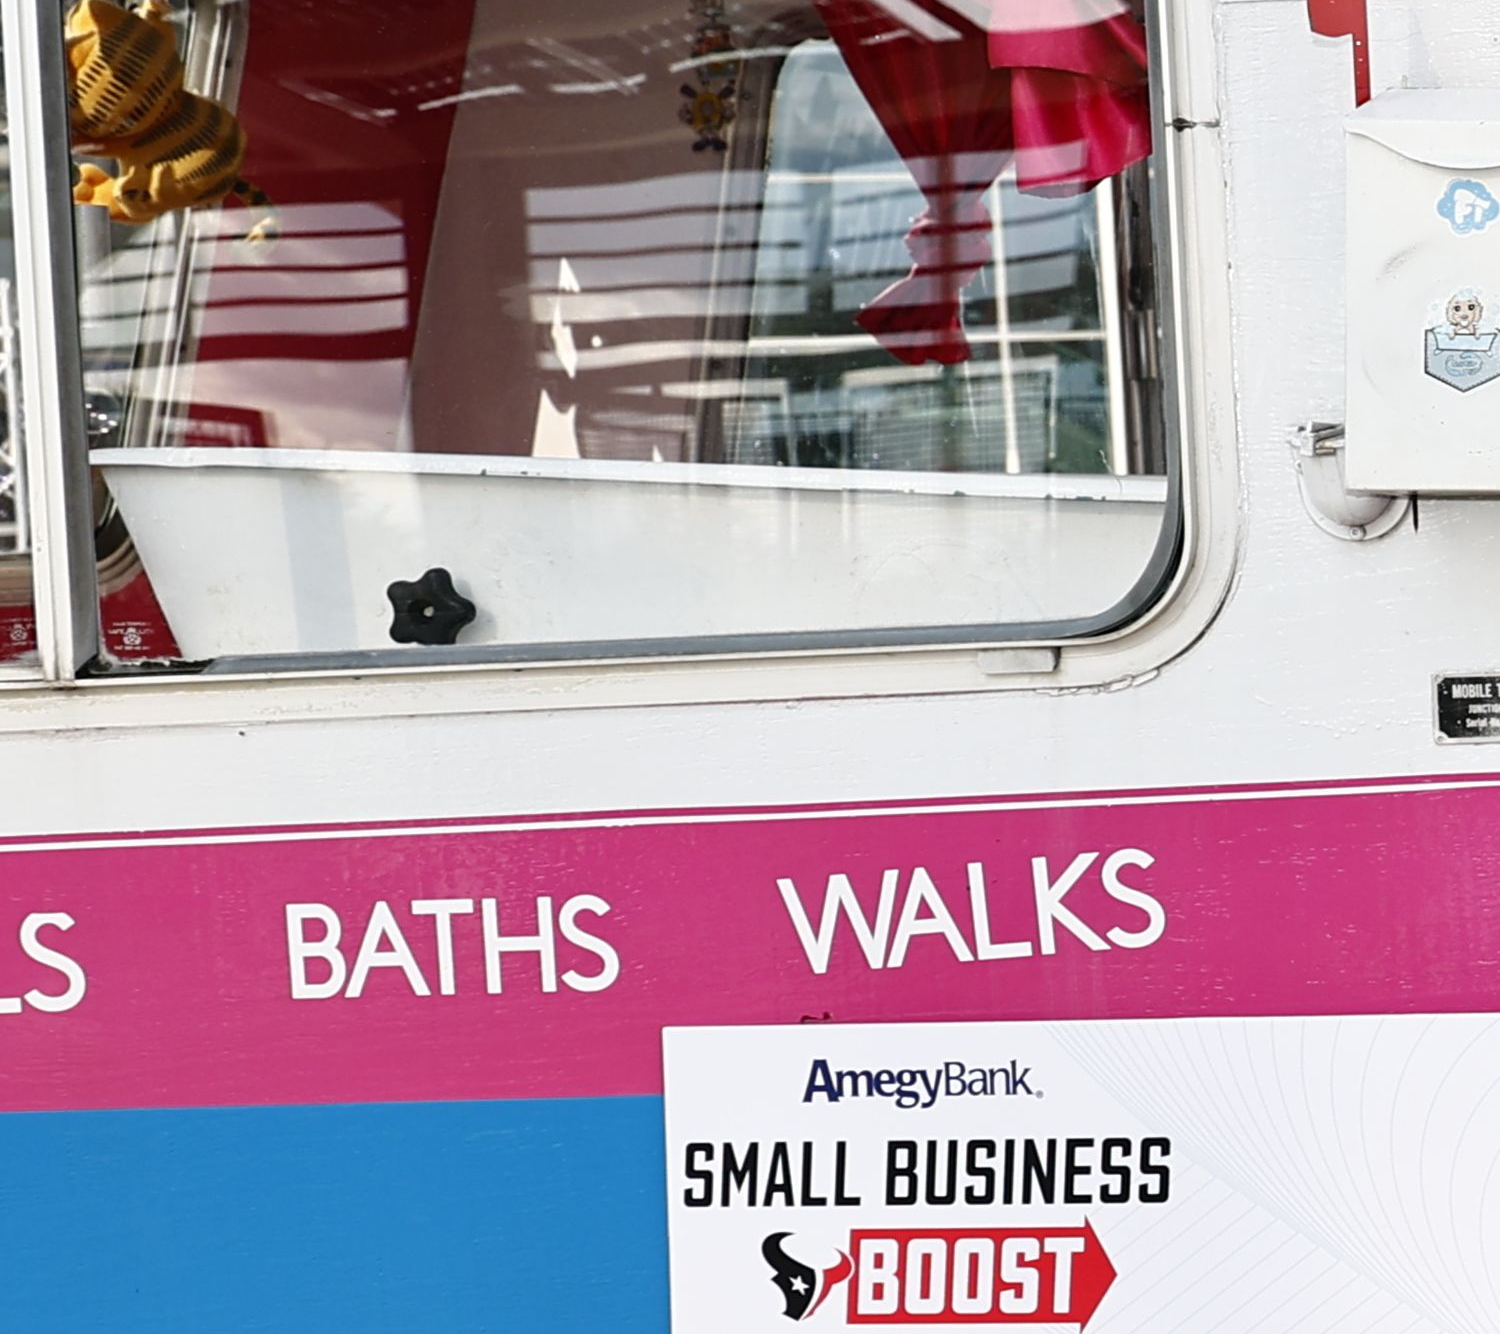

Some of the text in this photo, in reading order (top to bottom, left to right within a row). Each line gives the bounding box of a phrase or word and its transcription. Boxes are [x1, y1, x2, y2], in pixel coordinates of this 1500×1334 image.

[1452, 683, 1492, 699] MOBILE
[285, 894, 620, 1000] BATHS
[776, 848, 1166, 975] WALKS
[683, 1136, 1172, 1208] SMALL BUSINESS
[857, 1236, 1086, 1316] BOOST
